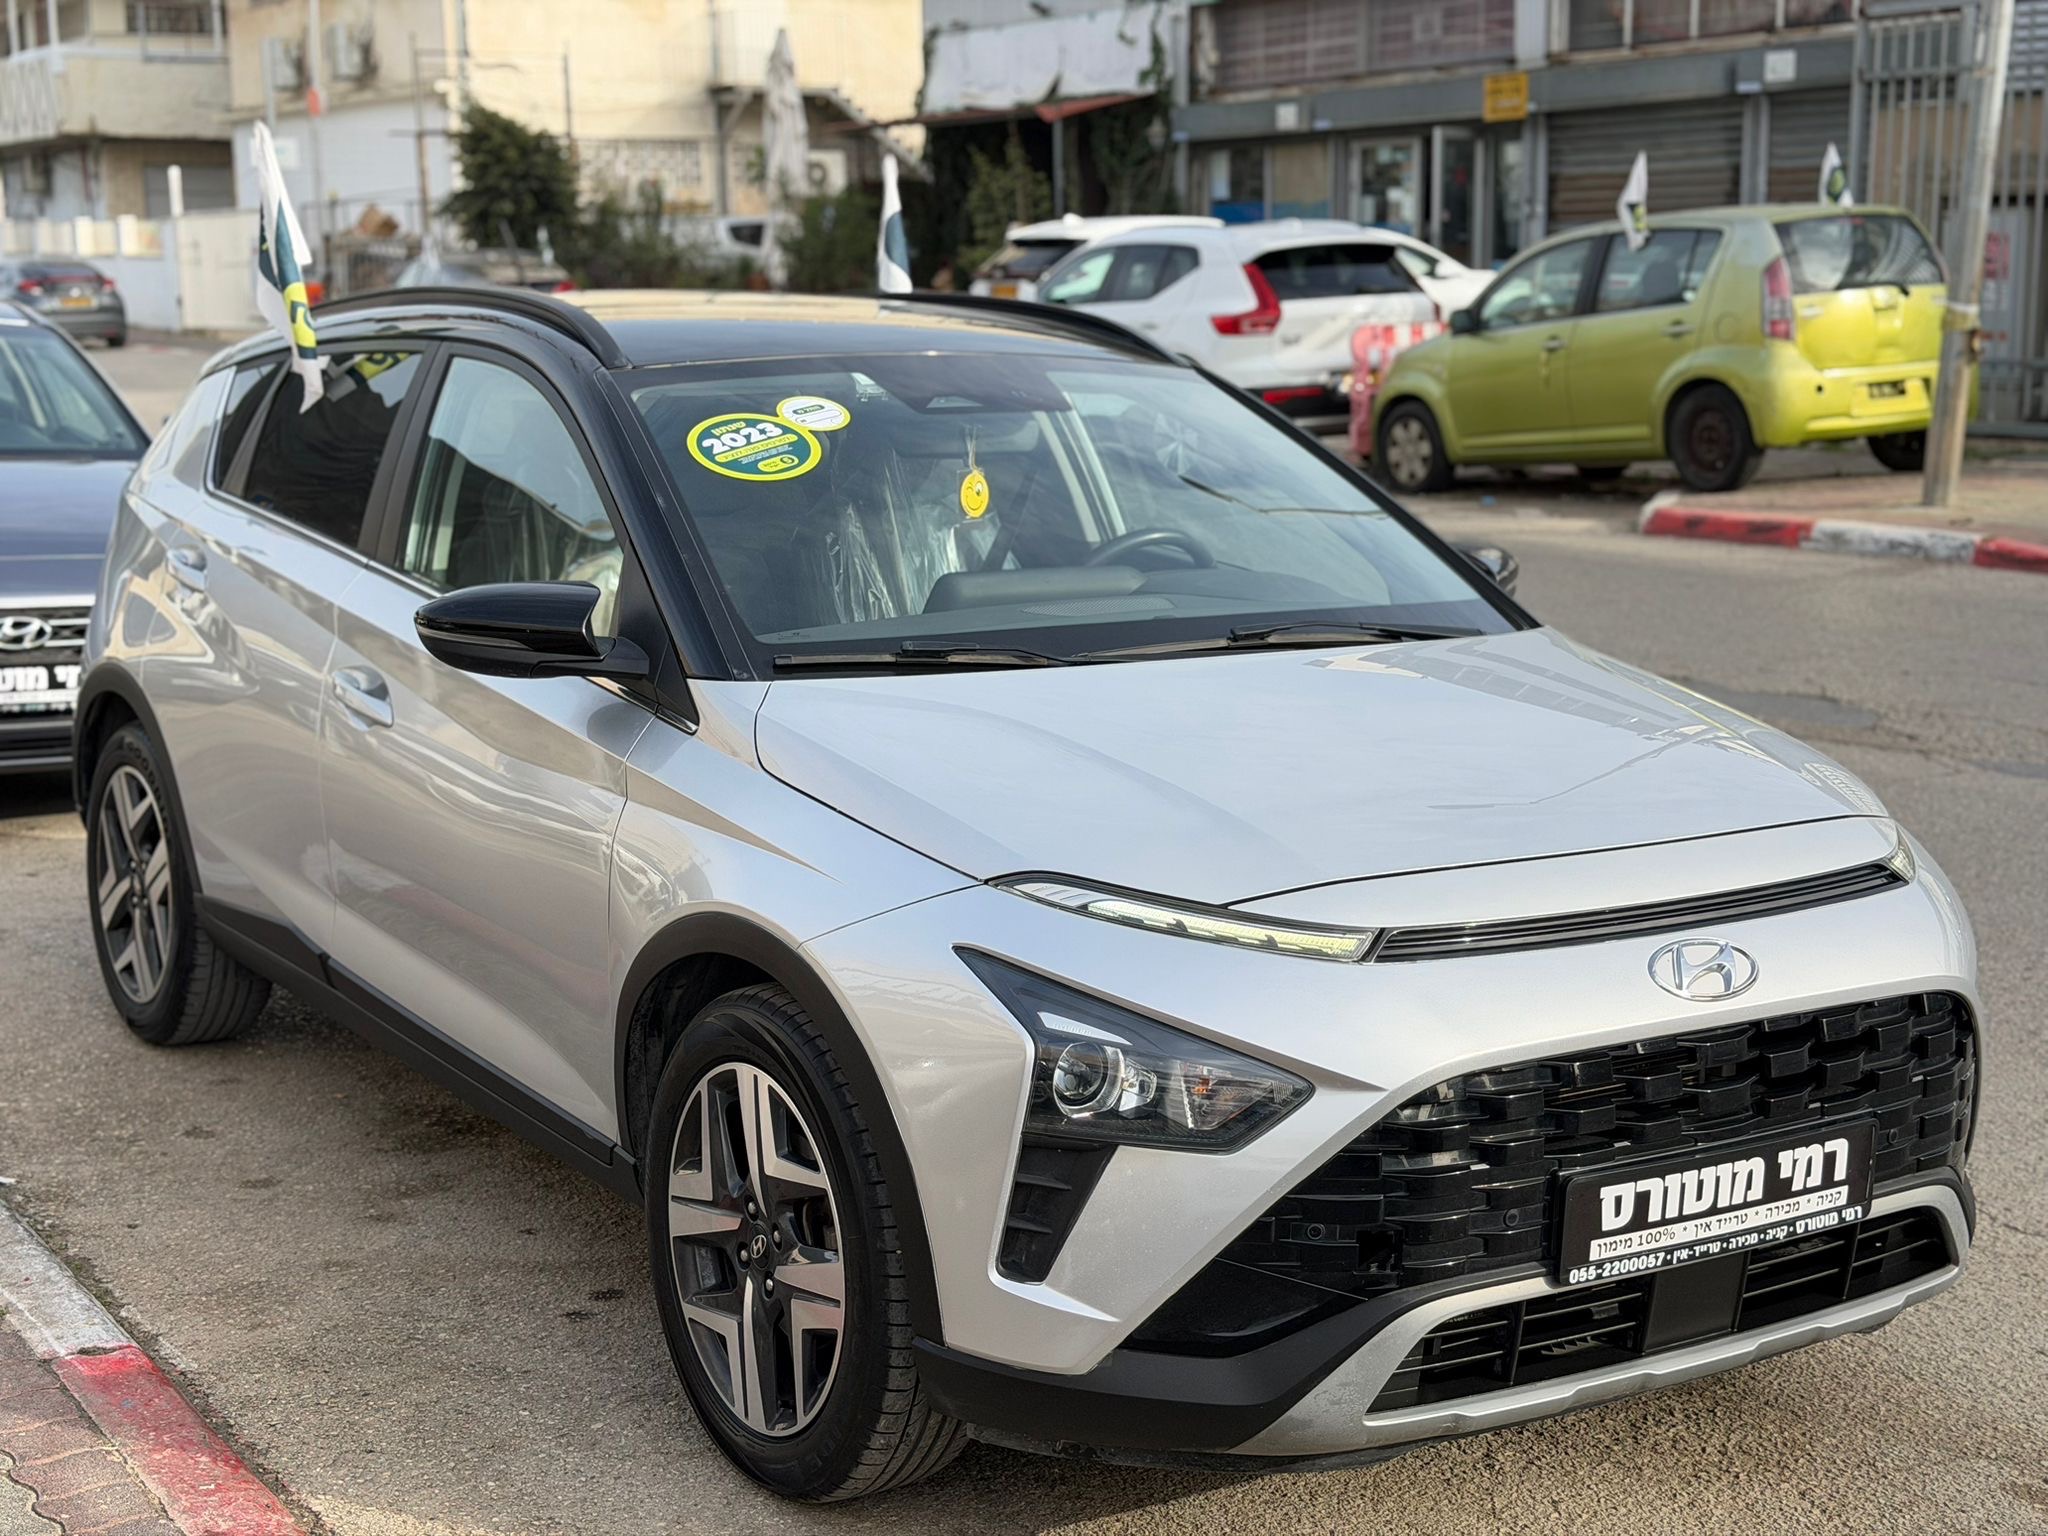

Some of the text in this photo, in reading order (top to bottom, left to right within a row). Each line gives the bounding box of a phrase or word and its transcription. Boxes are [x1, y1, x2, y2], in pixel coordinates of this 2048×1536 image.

[702, 422, 783, 455] 2023
[1600, 1138, 1849, 1231] רמי מוטורס
[1816, 1190, 1842, 1207] קניה
[1764, 1200, 1801, 1219] מכירה
[1841, 1205, 1863, 1220] רמי
[1693, 1221, 1712, 1238] אין
[1796, 1213, 1838, 1234] מוטורס
[1637, 1227, 1676, 1247] 100%
[1728, 1233, 1759, 1250] מכירה
[1765, 1225, 1788, 1241] קניה
[1597, 1239, 1632, 1257] מימון
[1569, 1252, 1665, 1284] 055-2200057
